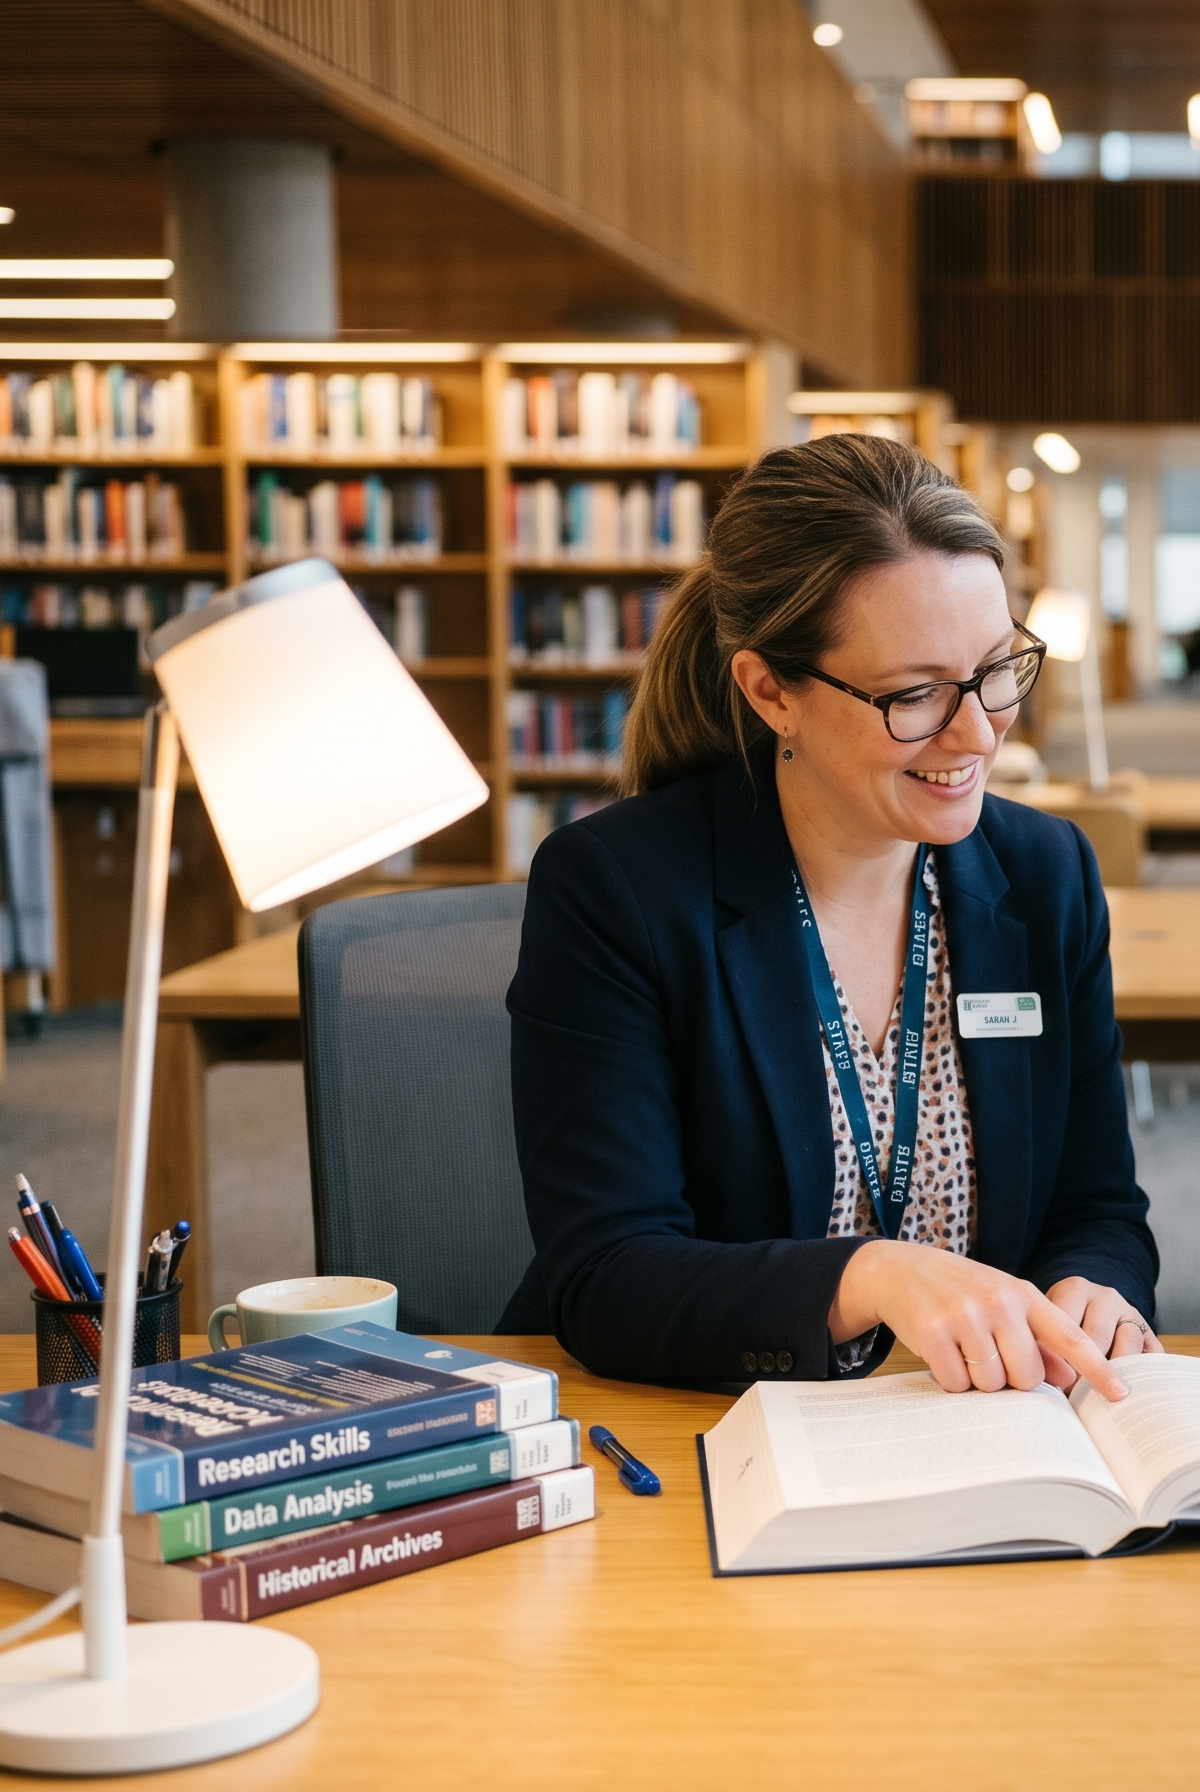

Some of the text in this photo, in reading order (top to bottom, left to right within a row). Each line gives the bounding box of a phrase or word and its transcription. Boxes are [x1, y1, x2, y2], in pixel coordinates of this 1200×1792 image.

[984, 1015, 1010, 1024] SARAH
[198, 1438, 306, 1487] Research
[310, 1426, 371, 1462] Skills
[224, 1503, 279, 1535] Data
[283, 1480, 374, 1521] Analysis
[257, 1548, 356, 1600] Historical
[360, 1530, 444, 1571] Archives
